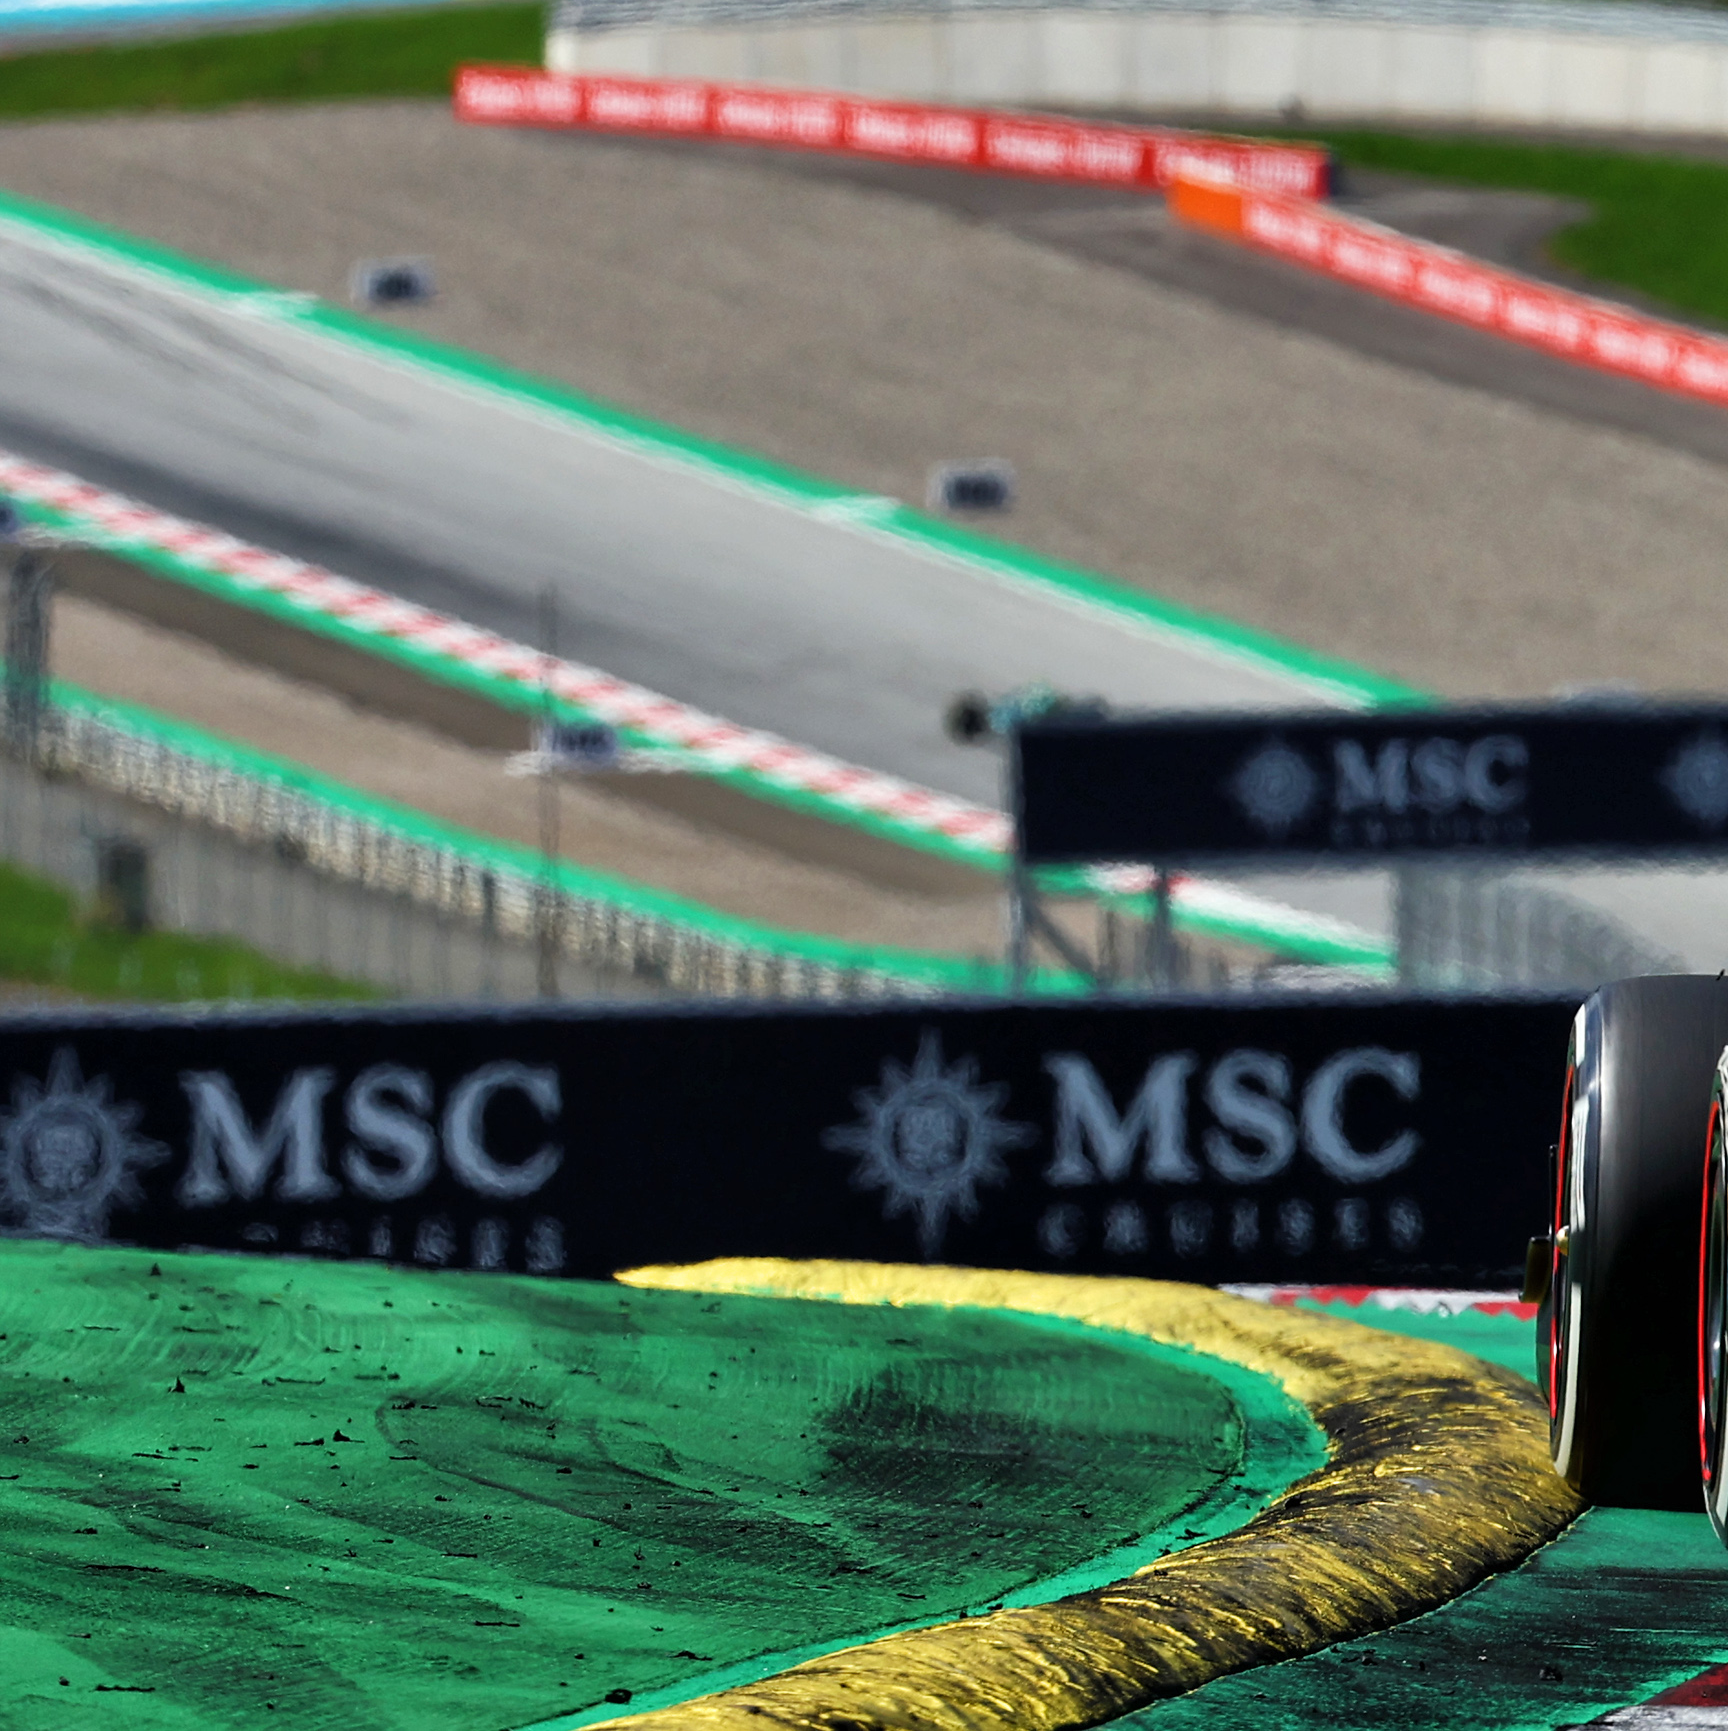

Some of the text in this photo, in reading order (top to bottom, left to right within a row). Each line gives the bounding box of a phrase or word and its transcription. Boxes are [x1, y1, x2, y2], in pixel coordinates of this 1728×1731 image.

[1334, 734, 1529, 813] MSC
[174, 1060, 564, 1205] MSC
[1041, 1045, 1422, 1184] MSC
